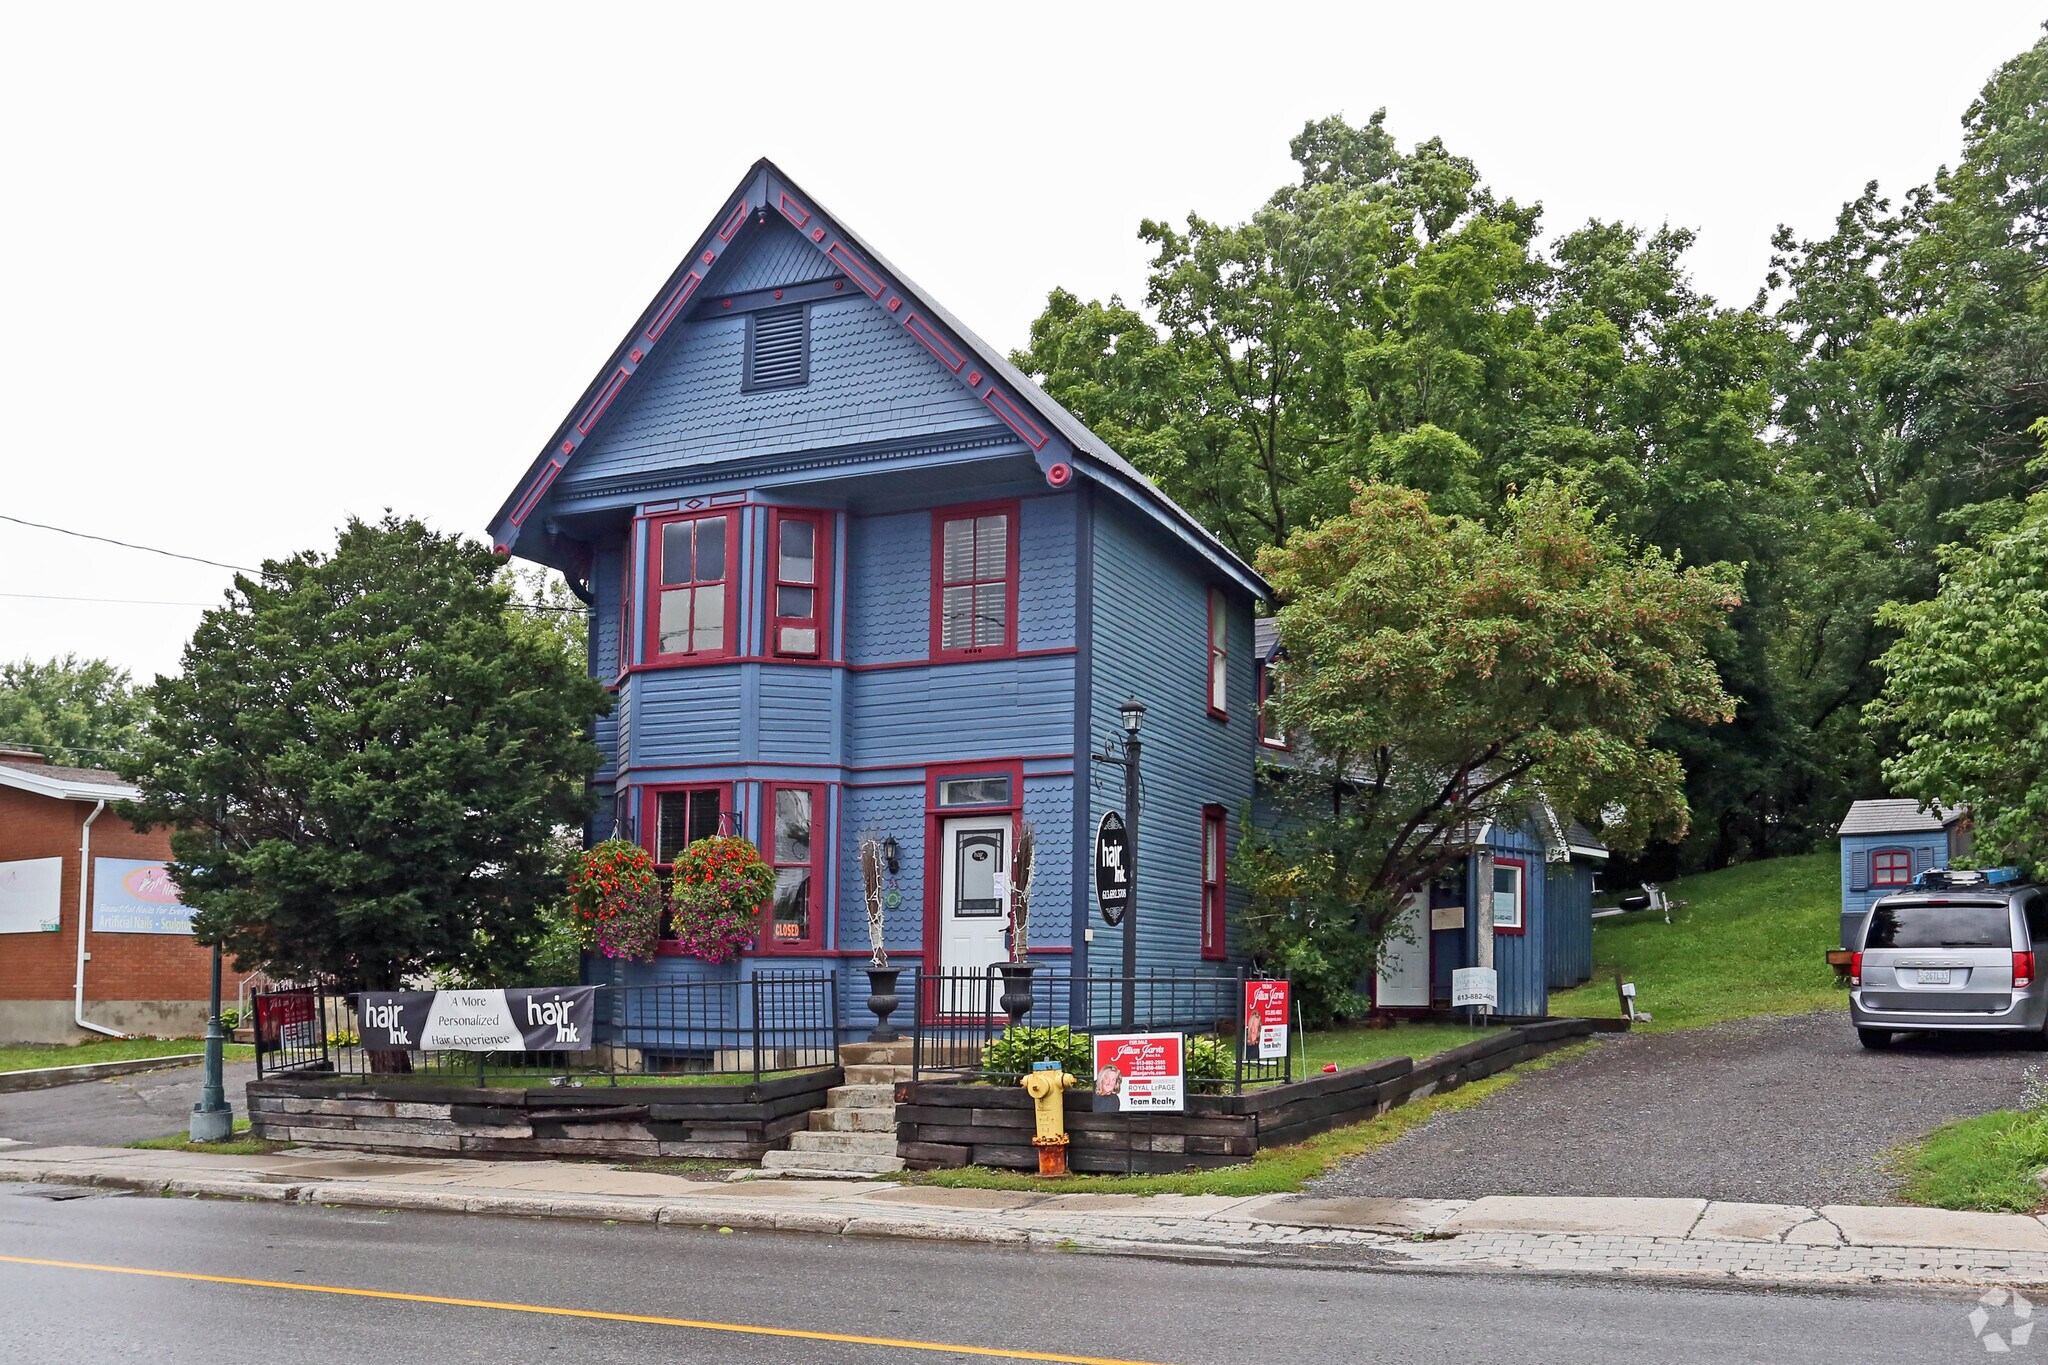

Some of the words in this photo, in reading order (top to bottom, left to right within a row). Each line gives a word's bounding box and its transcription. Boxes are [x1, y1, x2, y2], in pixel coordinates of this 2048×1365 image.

[1102, 838, 1123, 867] hair
[100, 903, 135, 913] Beautiful
[136, 905, 155, 914] Nails
[155, 906, 166, 915] for
[168, 907, 190, 917] Every
[99, 914, 133, 929] Artificial
[133, 916, 153, 929] Nails
[775, 923, 799, 937] CLOSED
[450, 997, 459, 1007] A
[461, 996, 487, 1007] More
[365, 998, 404, 1029] hair
[527, 994, 575, 1026] hair
[438, 1014, 500, 1027] Personalized
[431, 1034, 451, 1046] Hair
[454, 1034, 511, 1046] Experience
[1111, 1044, 1140, 1062] Jillian
[1135, 1043, 1164, 1061] Jarvis
[1152, 1096, 1177, 1106] Realty
